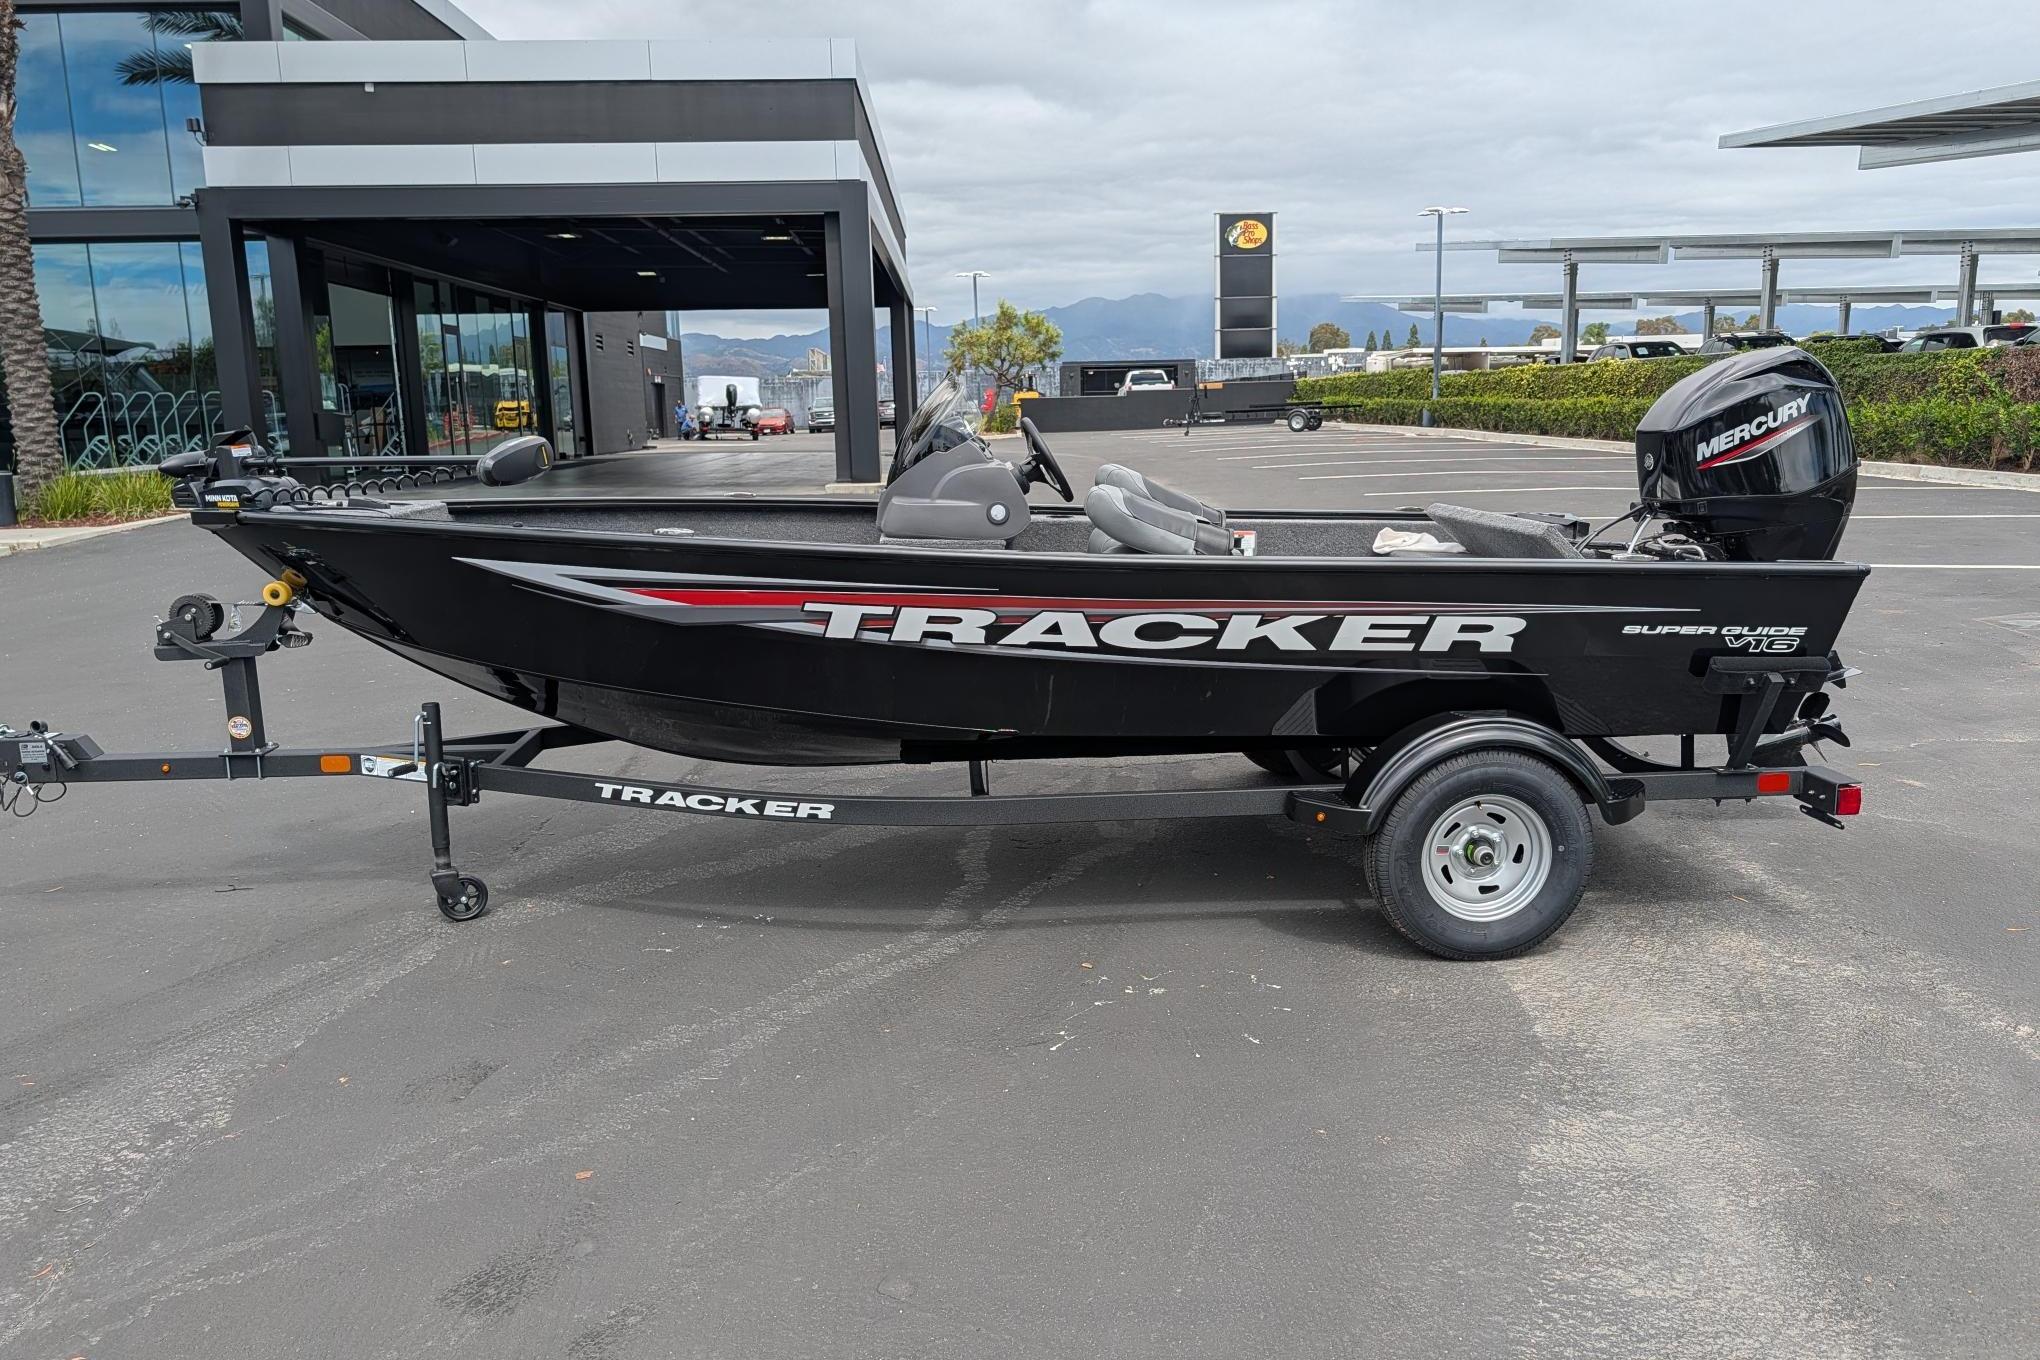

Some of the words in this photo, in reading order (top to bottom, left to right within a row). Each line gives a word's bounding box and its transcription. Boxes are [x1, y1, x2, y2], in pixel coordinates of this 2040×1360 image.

[1243, 221, 1259, 230] Bass
[1242, 236, 1262, 245] Shops
[1696, 392, 1811, 462] MERCURY
[204, 494, 221, 502] MINN
[221, 494, 239, 502] KOTA
[803, 602, 1527, 652] TRACKER
[1622, 625, 1717, 635] SUPER
[1720, 626, 1807, 636] GUIDE
[1725, 636, 1800, 653] V16
[595, 782, 835, 819] TRACKER
